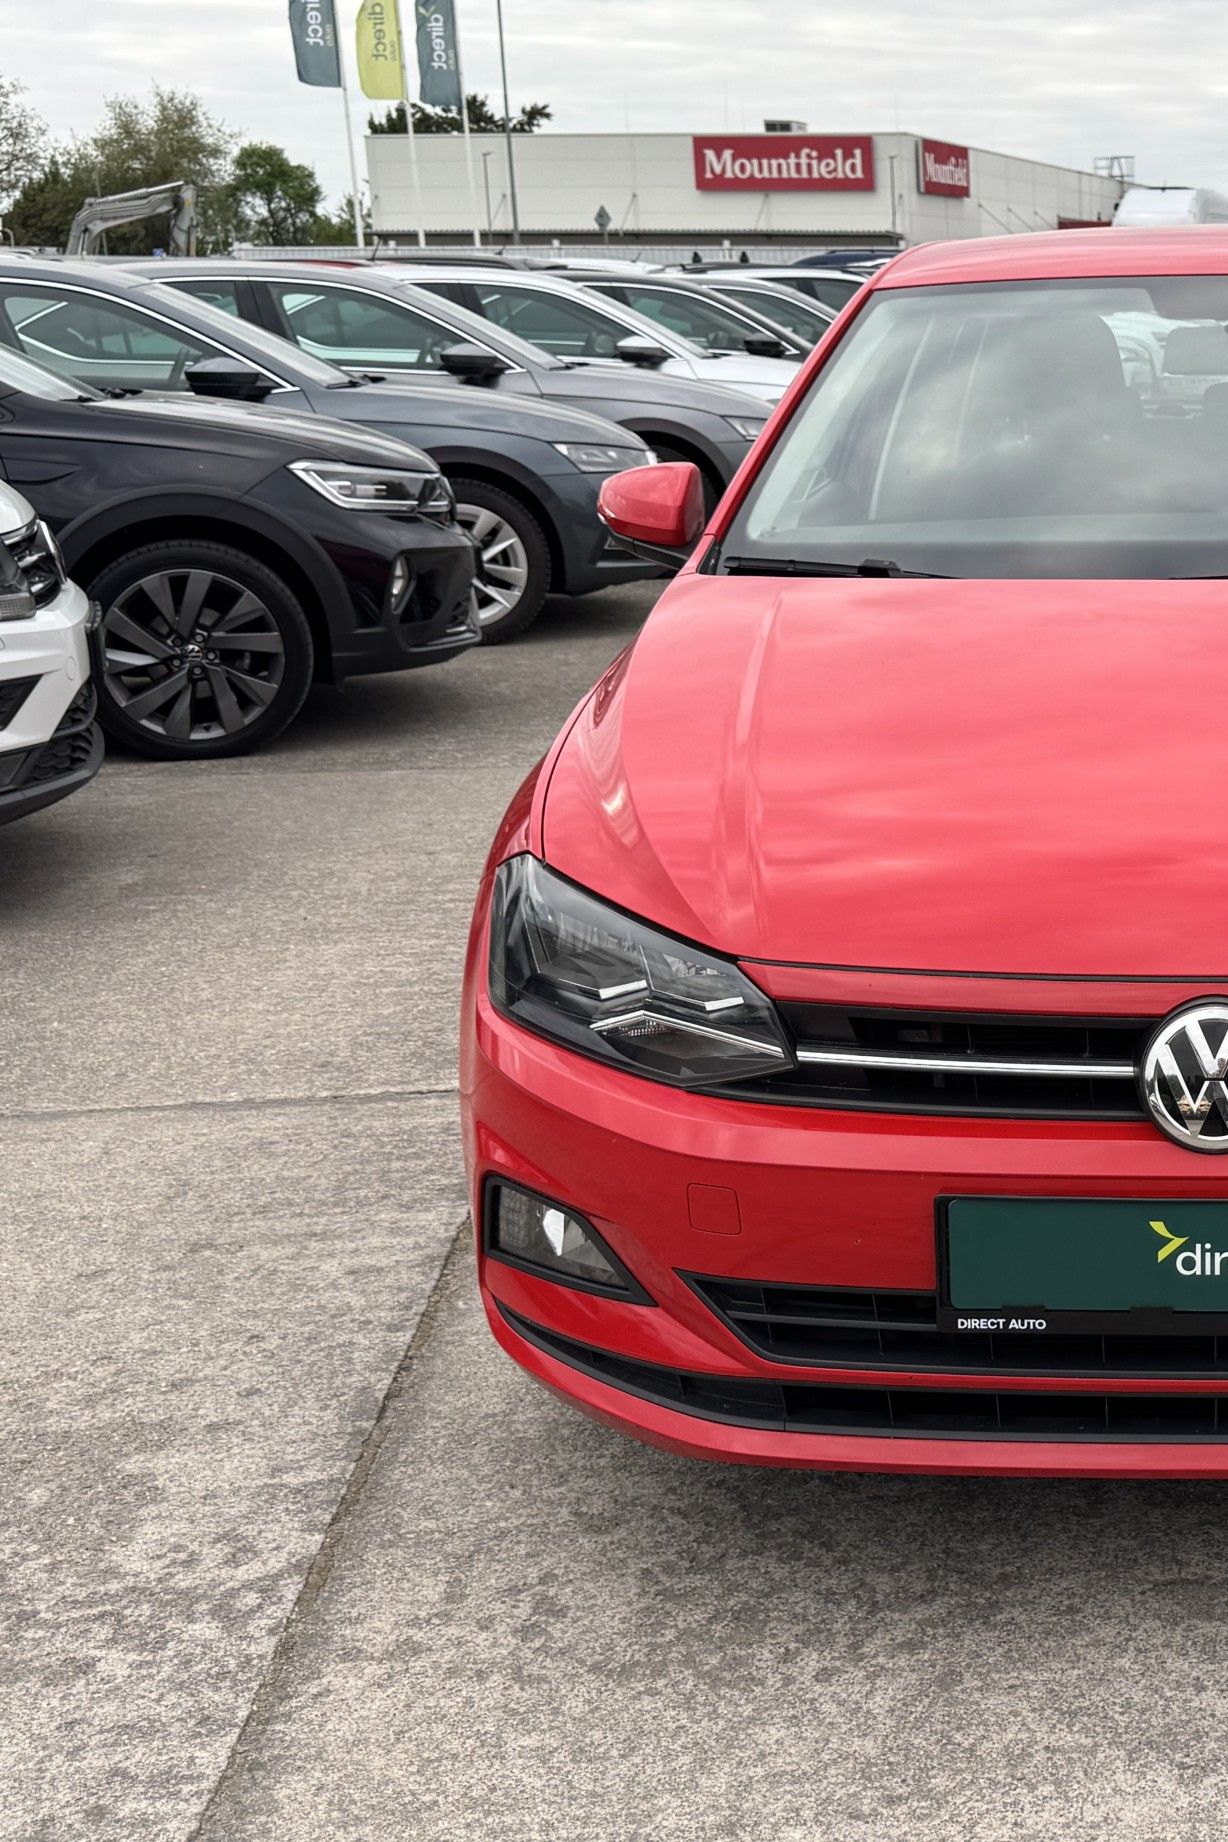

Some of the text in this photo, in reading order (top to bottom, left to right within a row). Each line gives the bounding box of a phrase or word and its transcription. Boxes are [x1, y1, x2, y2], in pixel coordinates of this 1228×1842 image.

[703, 148, 864, 179] Mountfield
[924, 152, 968, 187] Mountfield
[957, 1318, 1047, 1331] DIRECT AUTO
